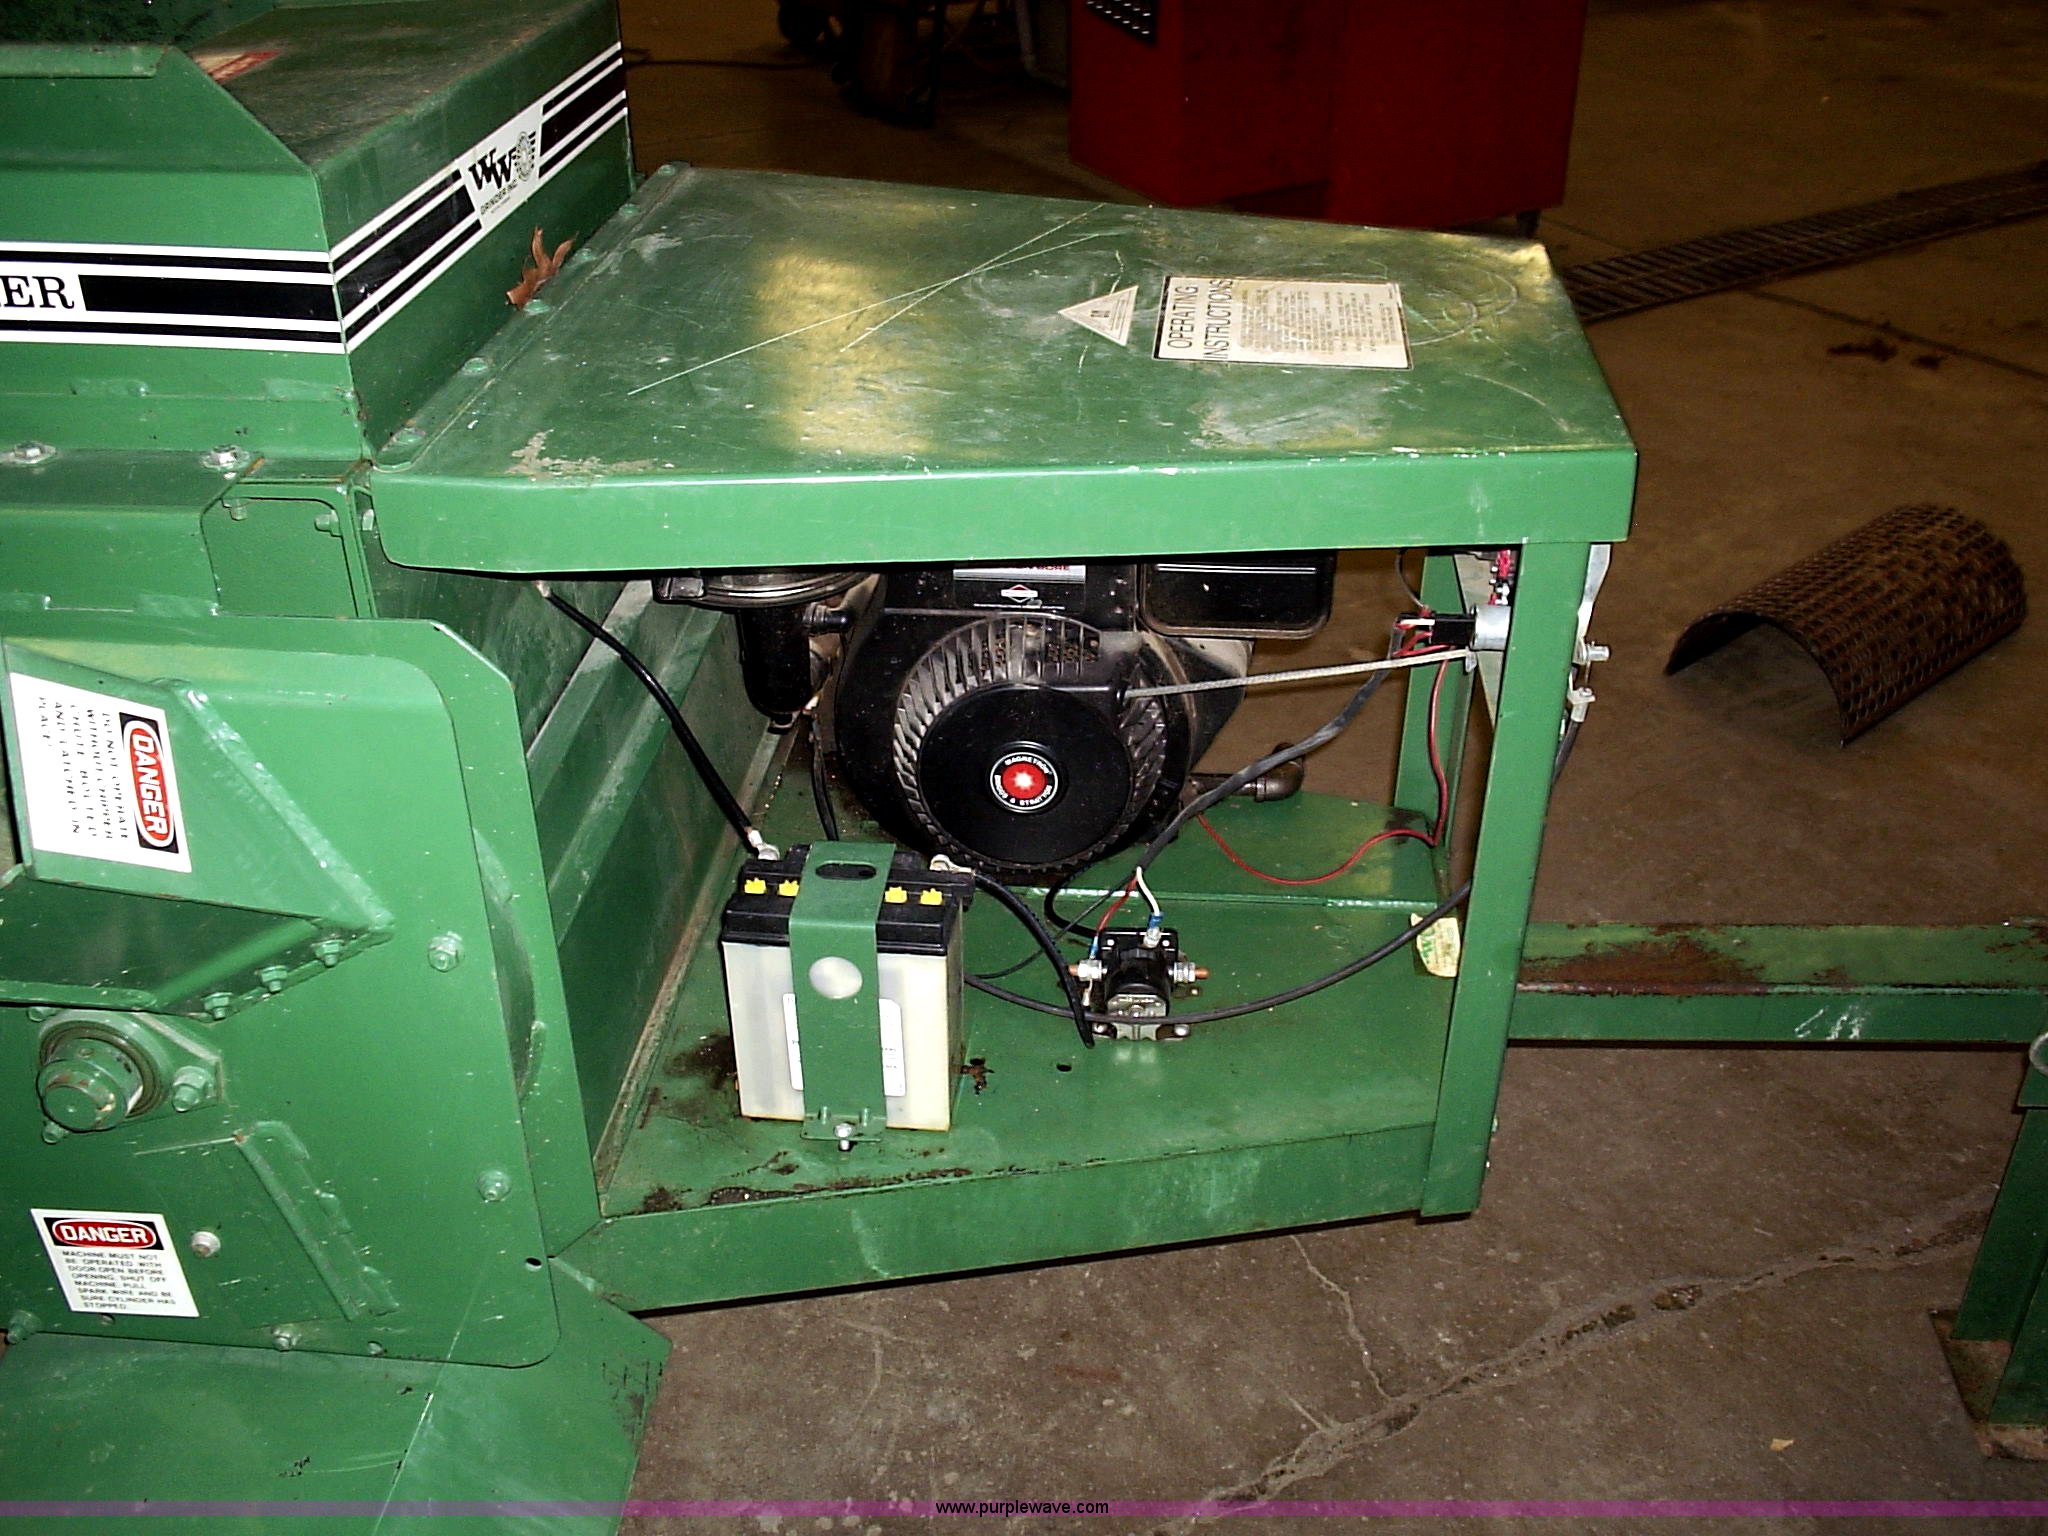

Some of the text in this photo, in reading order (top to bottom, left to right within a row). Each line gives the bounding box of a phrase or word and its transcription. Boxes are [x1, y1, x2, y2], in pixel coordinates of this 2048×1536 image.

[0, 274, 75, 310] ER
[1167, 286, 1198, 349] OPERATING
[1203, 279, 1234, 360] INSTRUCTIONS
[130, 732, 168, 835] DANGER
[58, 1224, 149, 1243] DANGER
